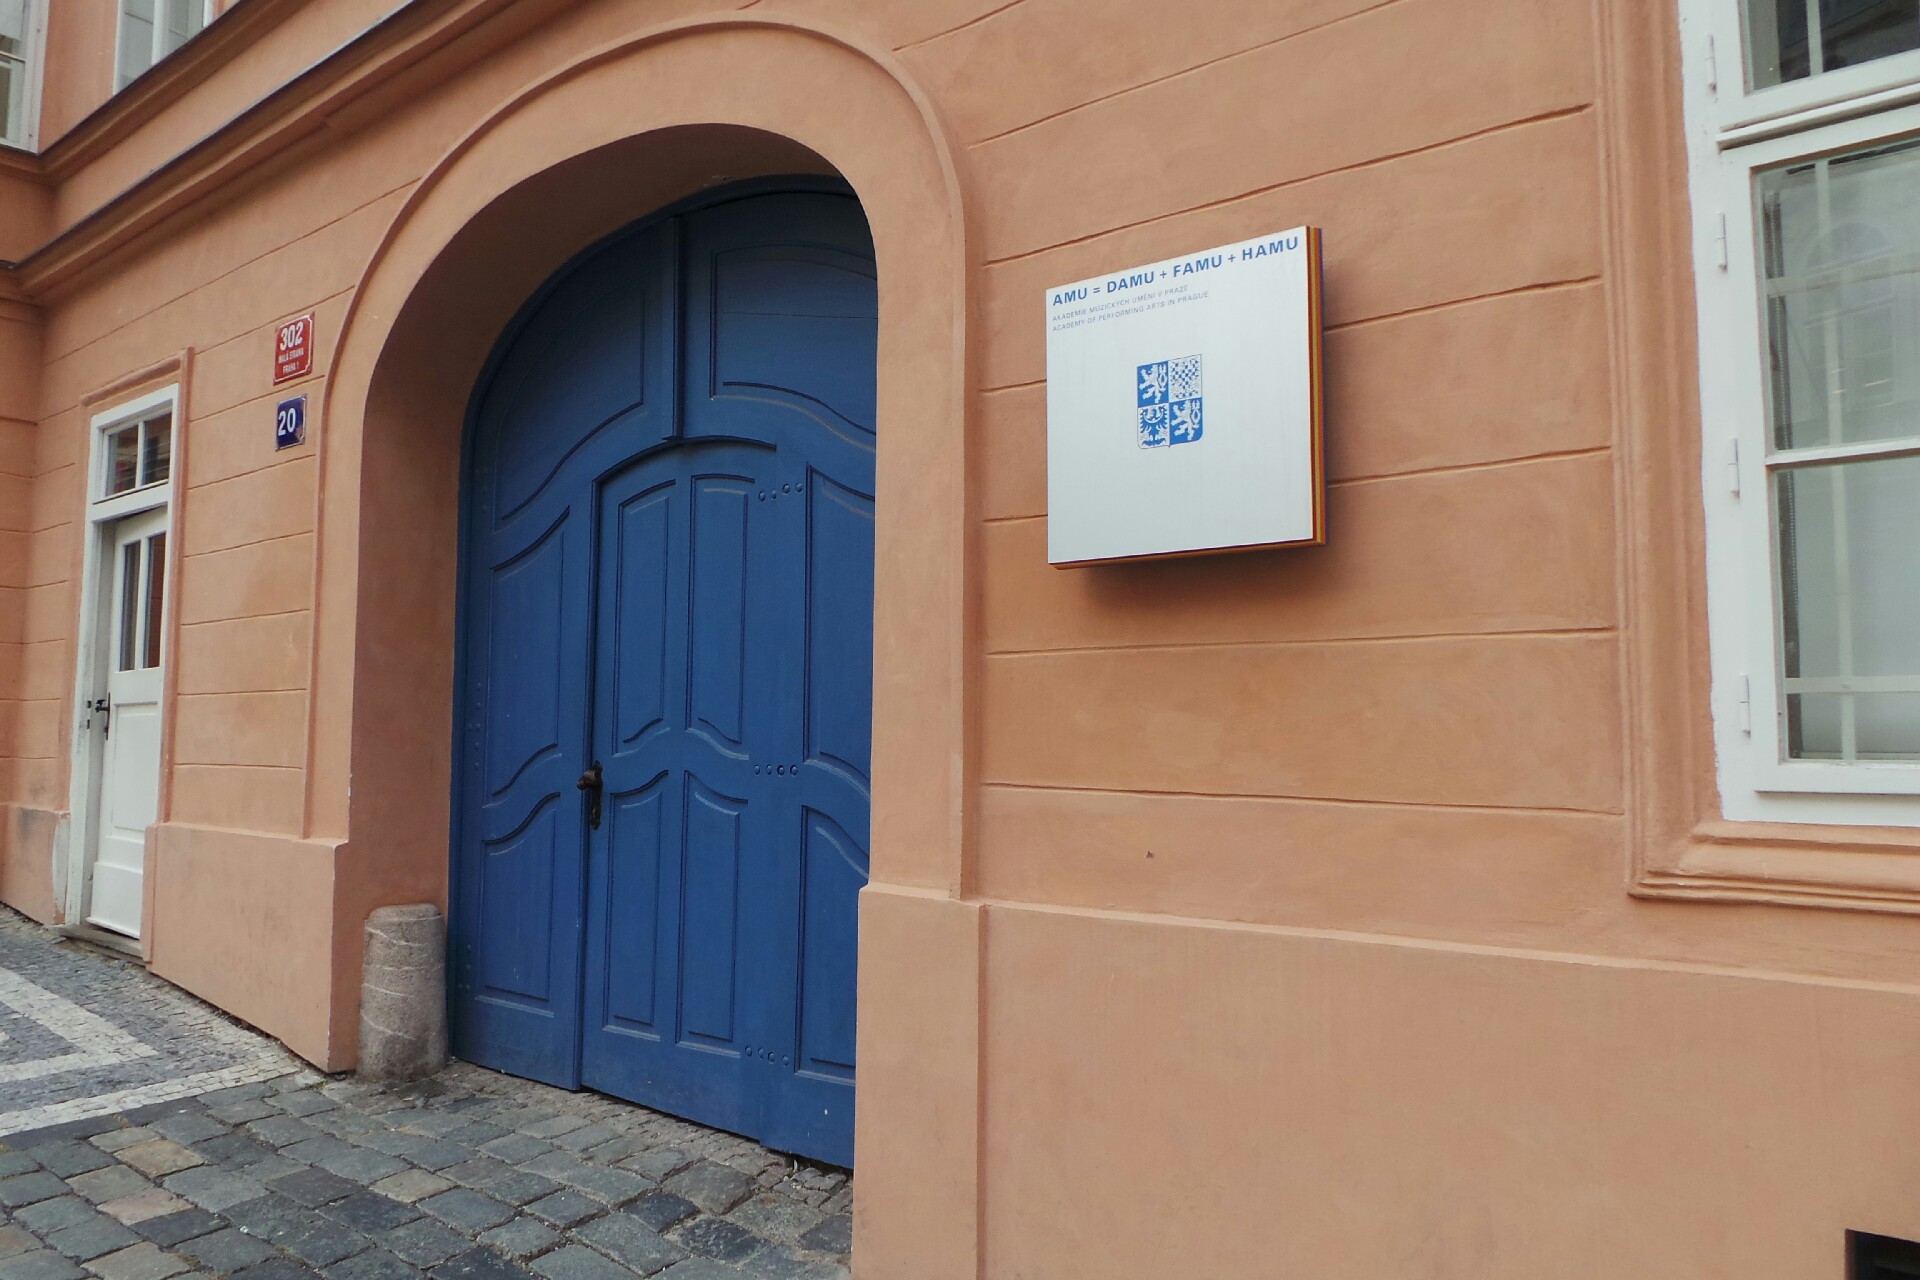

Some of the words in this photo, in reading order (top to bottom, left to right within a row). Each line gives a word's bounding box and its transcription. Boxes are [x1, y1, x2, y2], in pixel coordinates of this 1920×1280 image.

[1052, 287, 1088, 306] AMU
[1106, 271, 1155, 293] DAMU
[1173, 254, 1222, 278] FAMU
[1242, 236, 1299, 261] HAMU
[1052, 308, 1087, 321] AKADEMIE
[1164, 284, 1188, 296] PRAZE
[1052, 319, 1085, 331] ACADEMY
[1087, 316, 1096, 324] OF
[1098, 305, 1144, 321] PERFORMING
[1146, 301, 1165, 311] ARTS
[1177, 291, 1209, 304] PRAGUE
[280, 321, 303, 351] 302
[278, 408, 296, 436] 20
